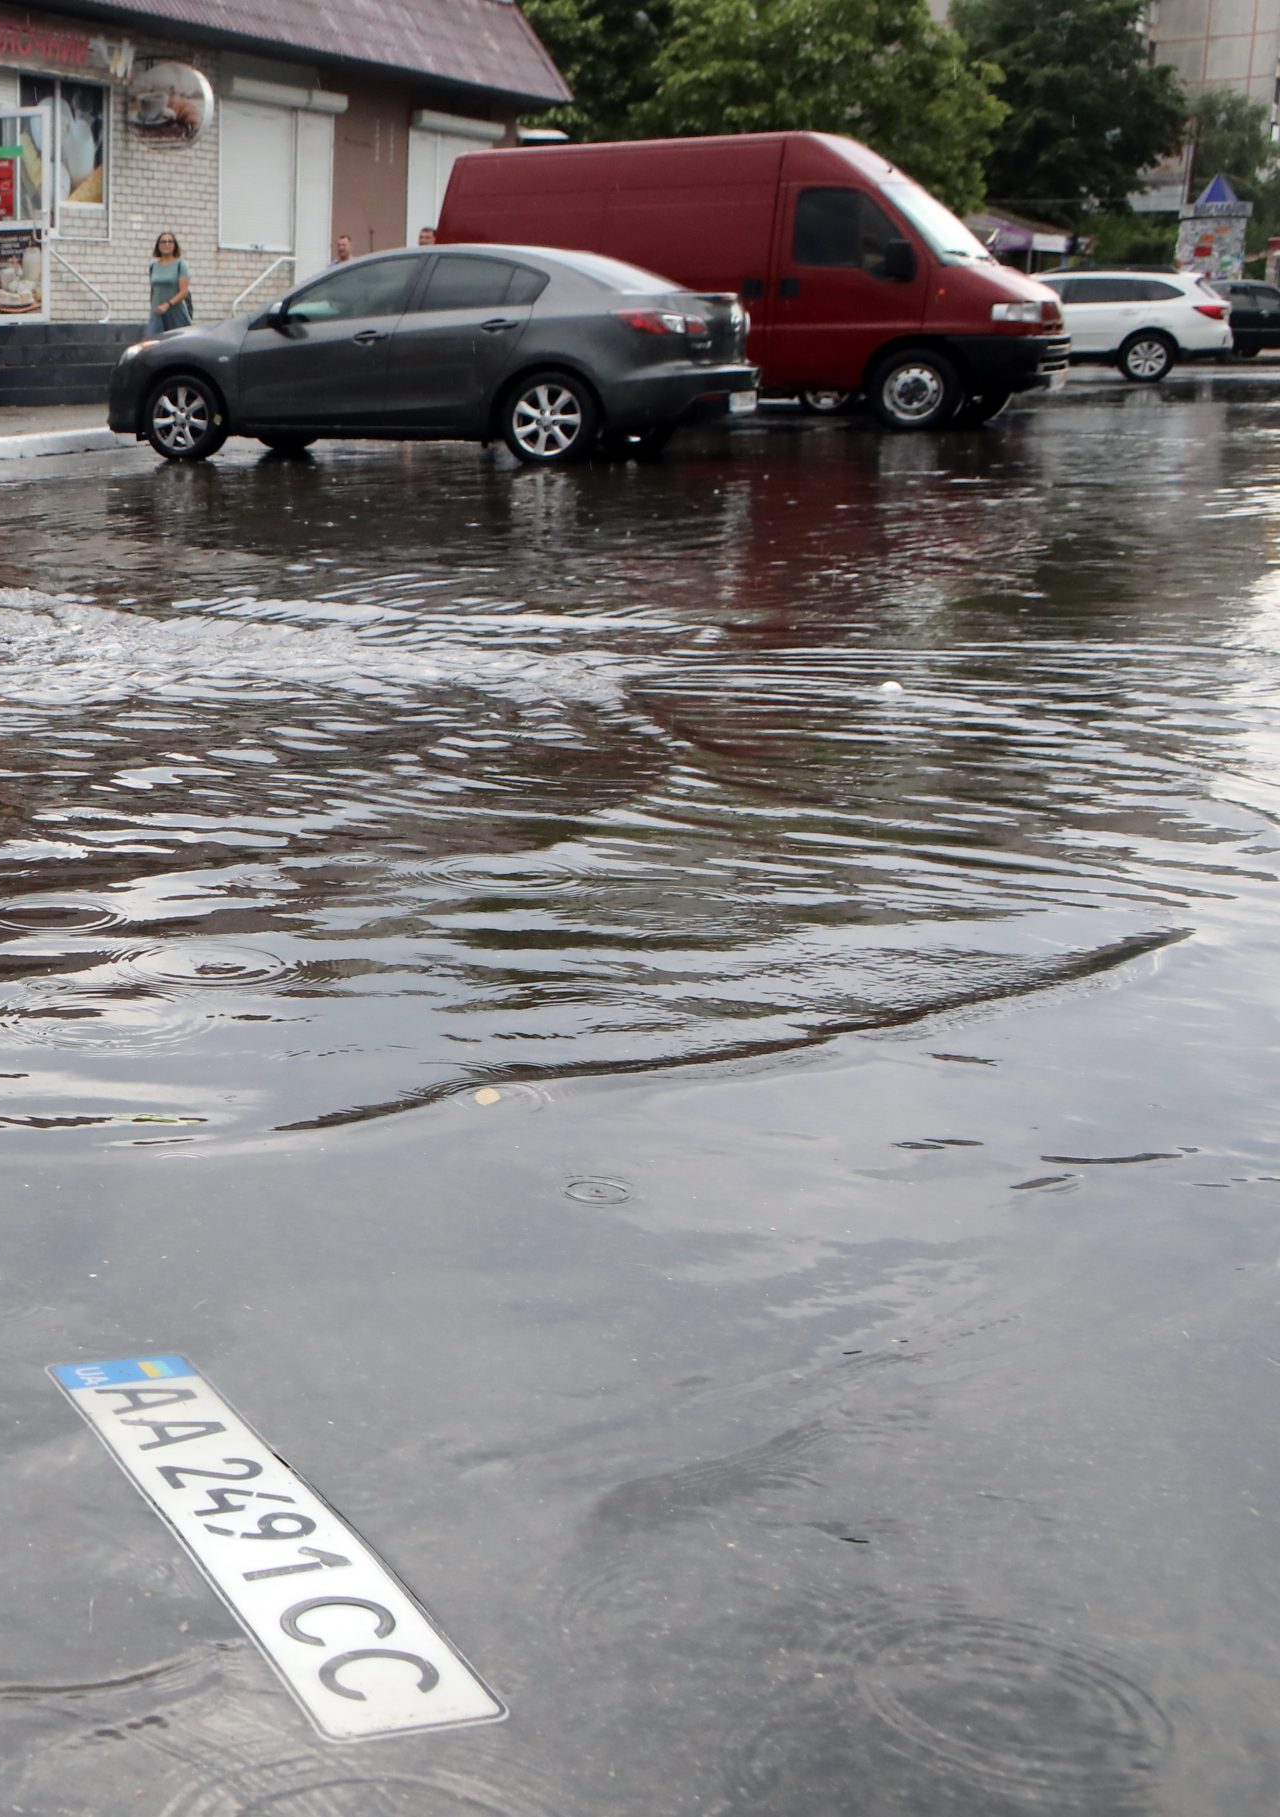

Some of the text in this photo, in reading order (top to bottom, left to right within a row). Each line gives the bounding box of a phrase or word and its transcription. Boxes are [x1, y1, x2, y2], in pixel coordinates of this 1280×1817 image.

[75, 1366, 109, 1386] UA
[94, 1388, 440, 1702] AA 2491 CC
